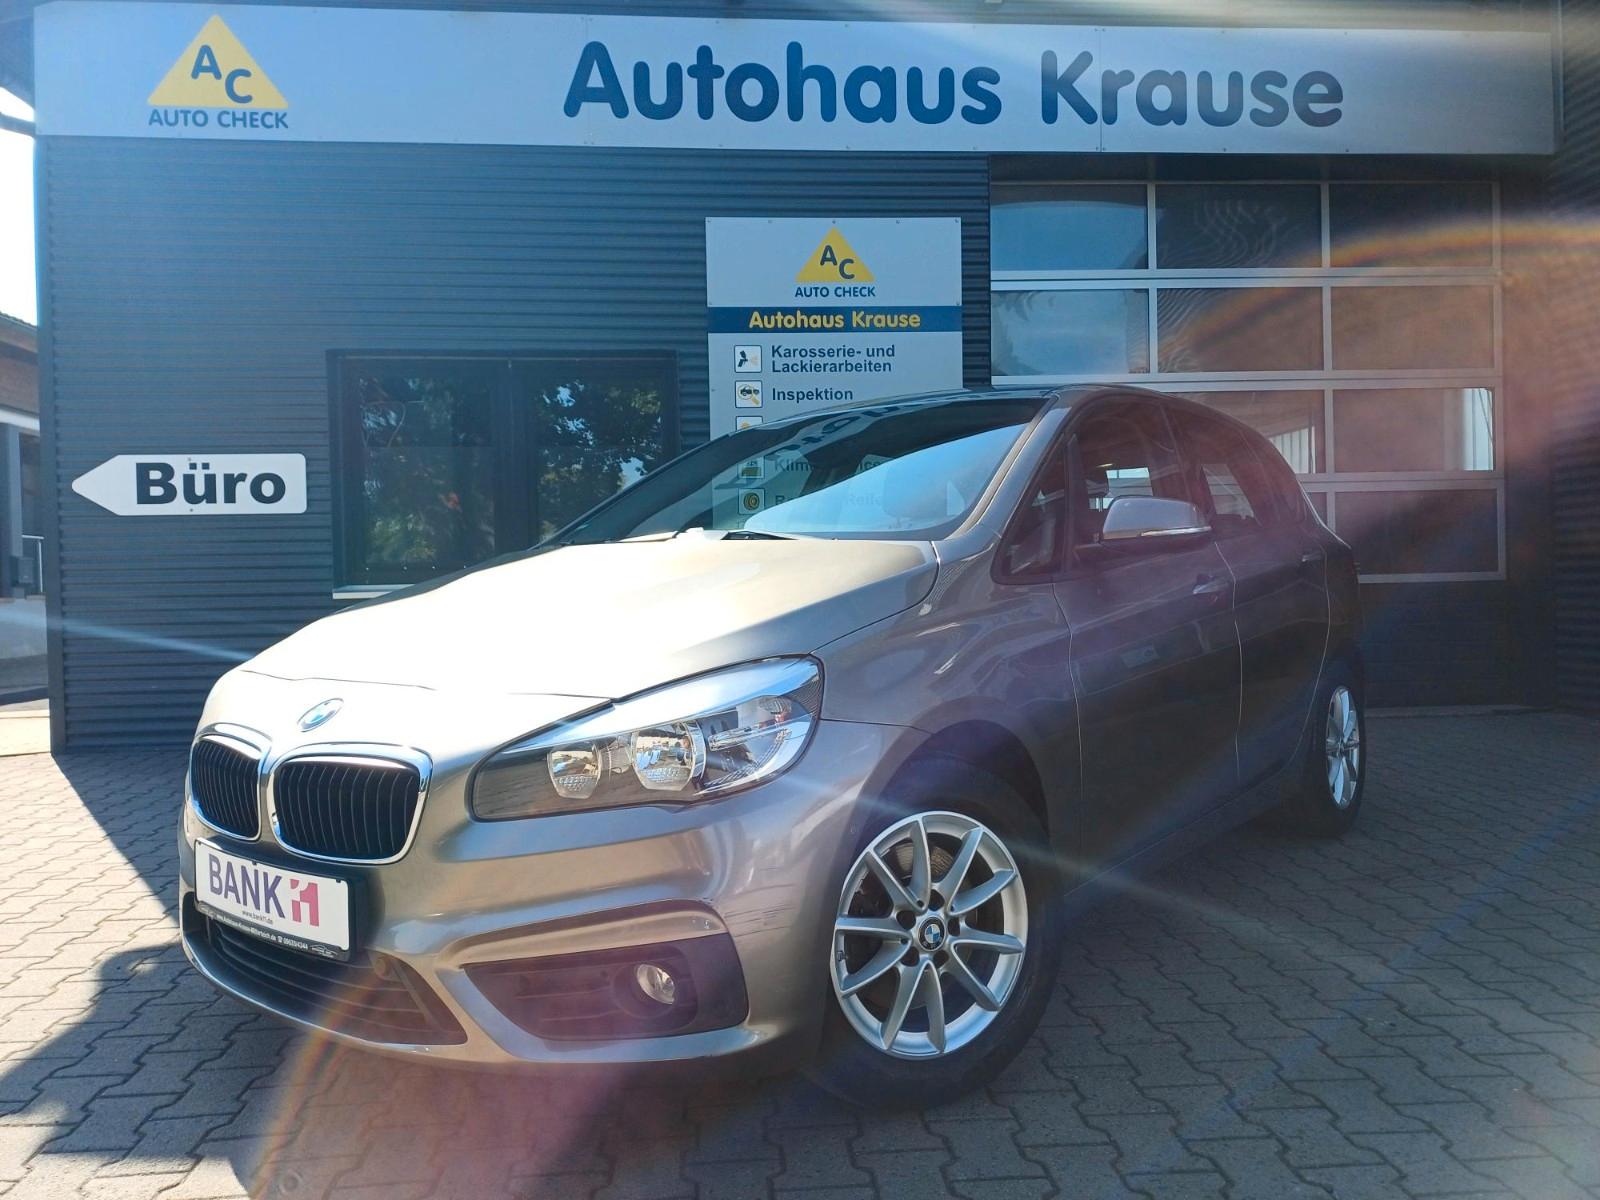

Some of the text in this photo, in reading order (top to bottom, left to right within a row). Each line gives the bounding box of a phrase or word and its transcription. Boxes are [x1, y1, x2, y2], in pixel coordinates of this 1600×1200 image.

[563, 41, 1344, 127] Autohaus Krause
[149, 108, 289, 129] AUTO CHECK
[795, 286, 876, 298] AUTO CHECK
[749, 310, 921, 329] Autohaus Krause
[771, 345, 895, 358] Karosserie- und
[771, 360, 892, 373] Lackierarbeiten
[771, 388, 854, 404] Inspektion
[135, 462, 287, 505] Büro
[208, 853, 286, 919] BANK
